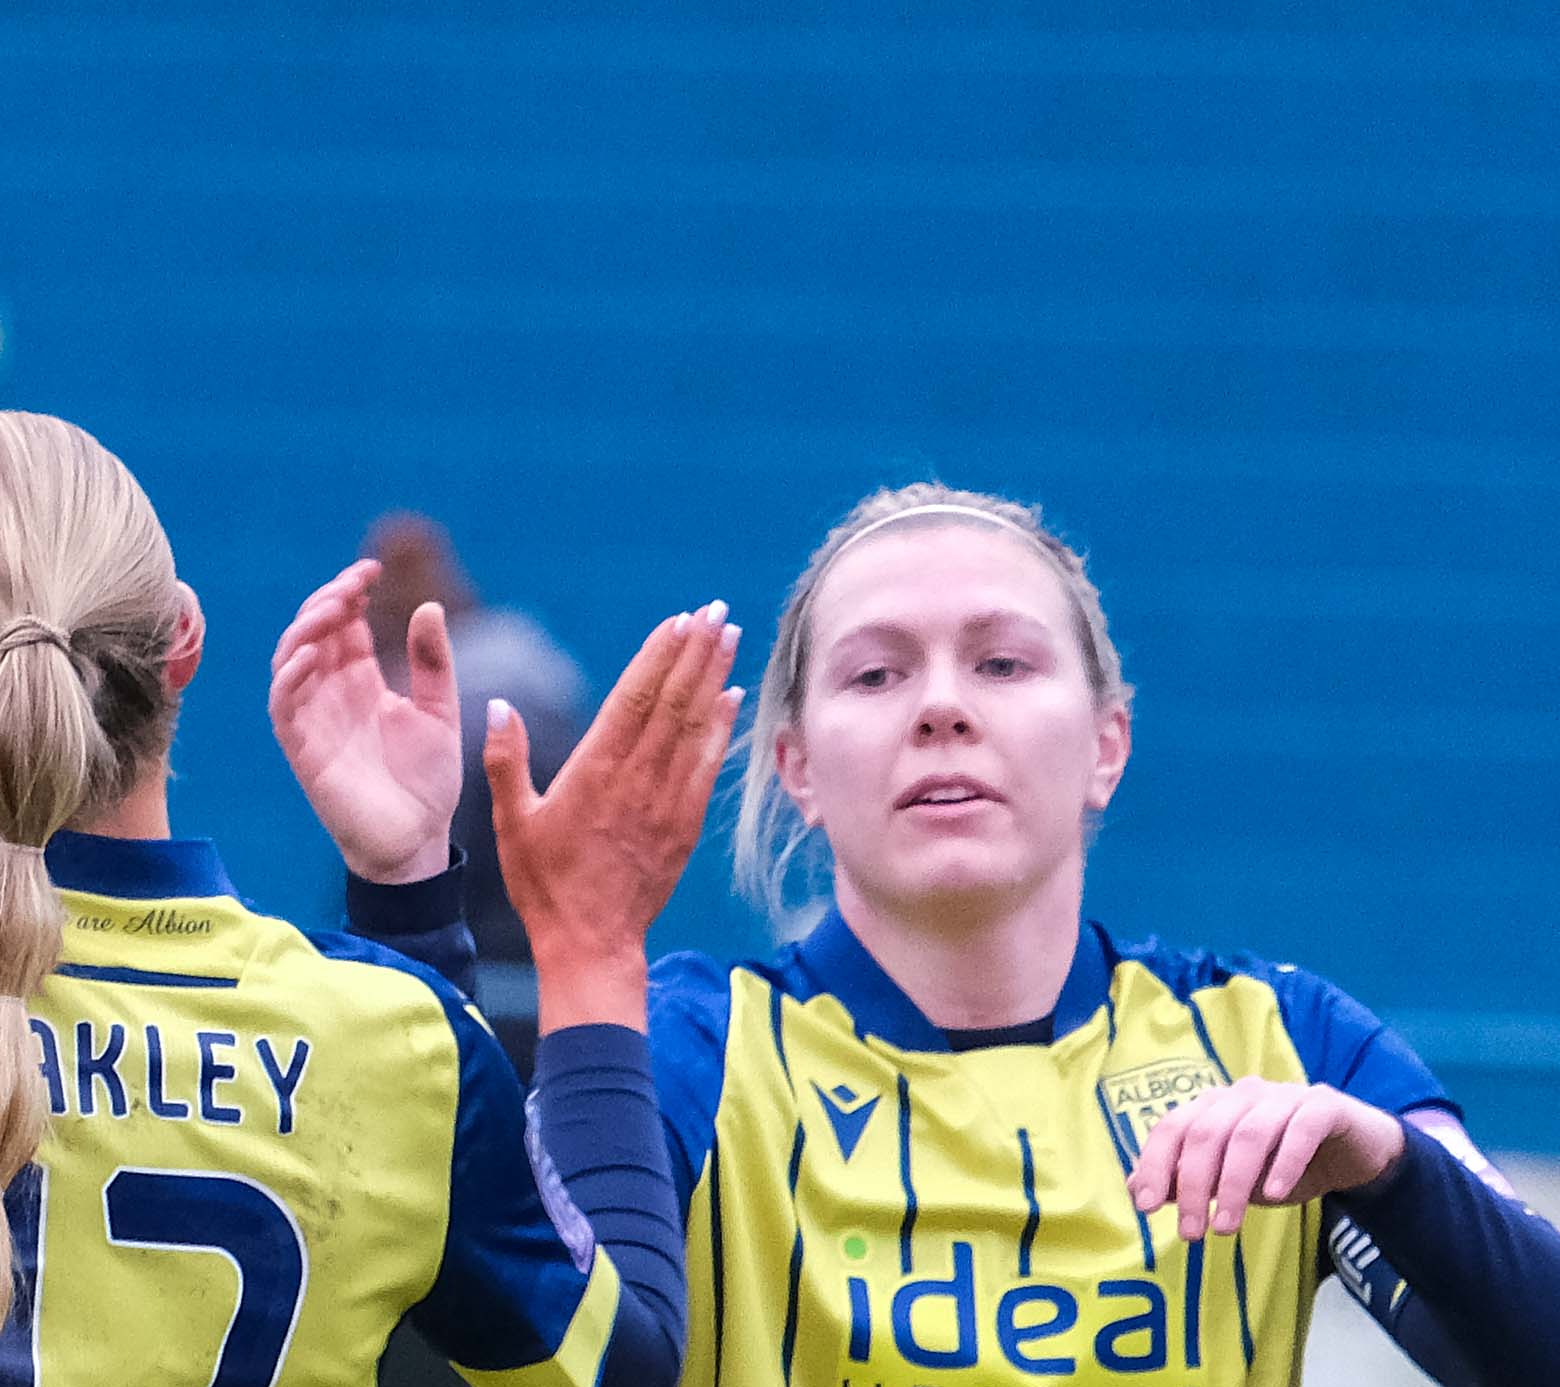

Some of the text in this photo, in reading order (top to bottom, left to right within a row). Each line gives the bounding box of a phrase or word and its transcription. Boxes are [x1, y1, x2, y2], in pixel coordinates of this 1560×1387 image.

[76, 909, 213, 936] are Albion
[843, 1236, 1206, 1377] ideal
